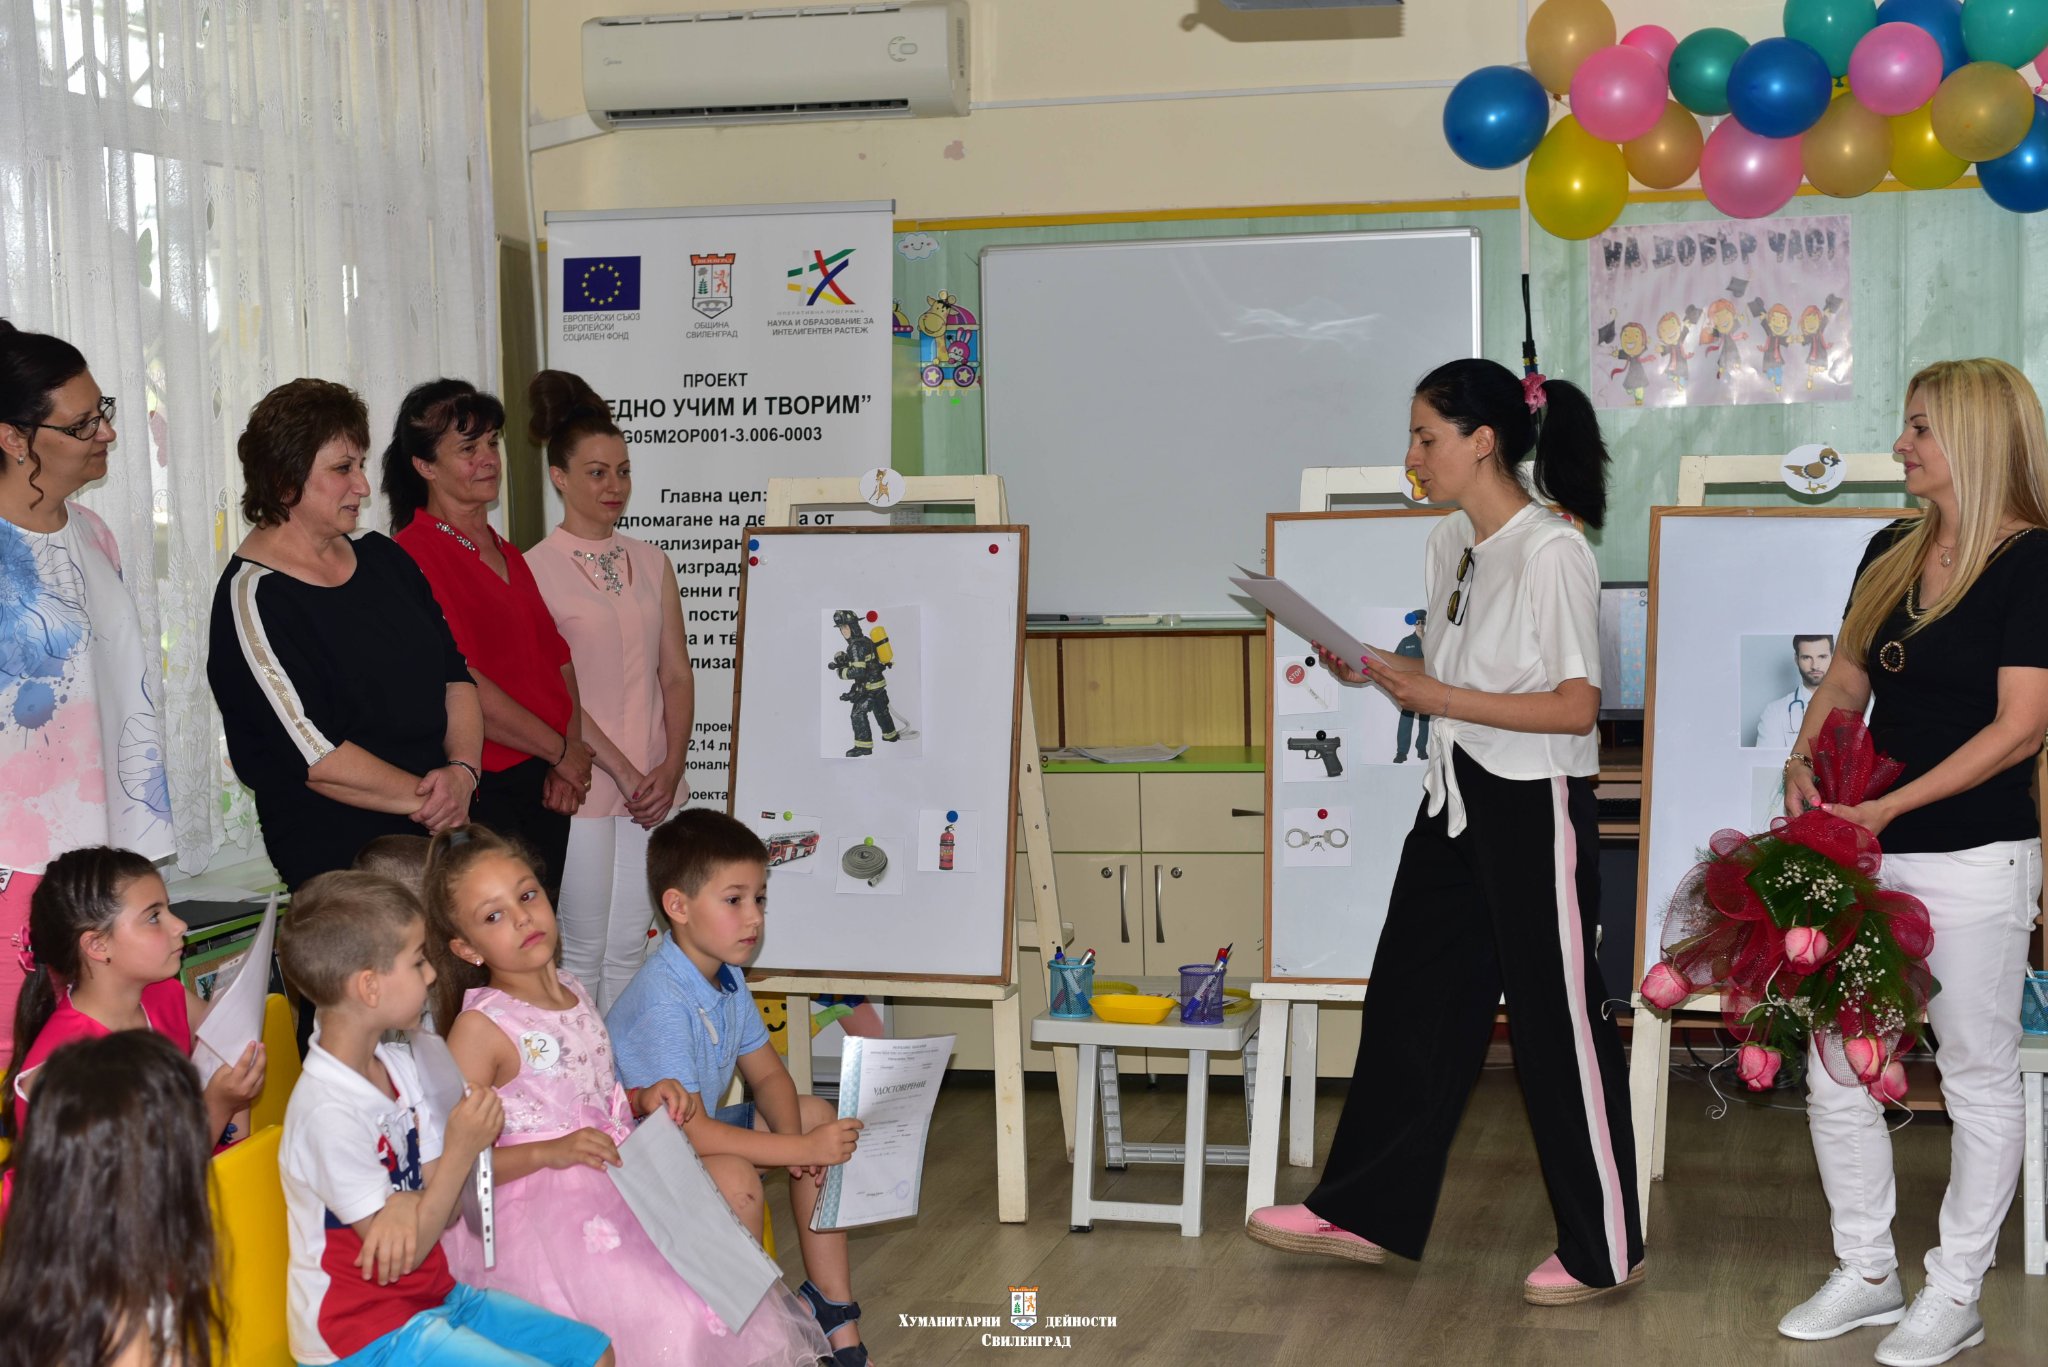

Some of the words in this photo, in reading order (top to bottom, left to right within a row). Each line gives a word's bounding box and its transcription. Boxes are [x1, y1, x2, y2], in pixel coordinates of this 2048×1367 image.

[1602, 236, 1641, 271] НА
[1767, 227, 1837, 263] ЧАС!
[563, 312, 615, 323] ЕВРОПЕЙСКИ
[616, 312, 641, 321] СЪЮЗ
[767, 319, 793, 327] НАУКА
[802, 317, 862, 326] ОБРАЗОВАНИЕ
[863, 317, 875, 325] ЗА
[563, 322, 615, 332] ЕВРОПЕЙСКИ
[693, 321, 730, 331] ОБЩИНА
[772, 327, 832, 336] ИНТЕЛИГЕНТЕН
[834, 326, 869, 335] РАСТЕЖ
[563, 332, 605, 342] СОЦИАЛЕН
[606, 331, 629, 341] ФОНД
[685, 329, 739, 339] СВИЛЕНГРАД
[683, 373, 748, 388] ПРОЕКТ
[673, 397, 735, 418] УЧИМ
[742, 397, 757, 416] И
[660, 489, 723, 504] Главна
[729, 490, 767, 505] цел:
[613, 514, 714, 530] дпомагане
[719, 514, 740, 526] на
[814, 513, 835, 526] от
[679, 586, 723, 598] енни
[686, 633, 698, 645] а
[704, 634, 714, 645] и
[690, 657, 736, 669] лиза
[1288, 667, 1302, 682] STOP
[688, 790, 728, 800] оекта
[537, 1038, 550, 1053] 2
